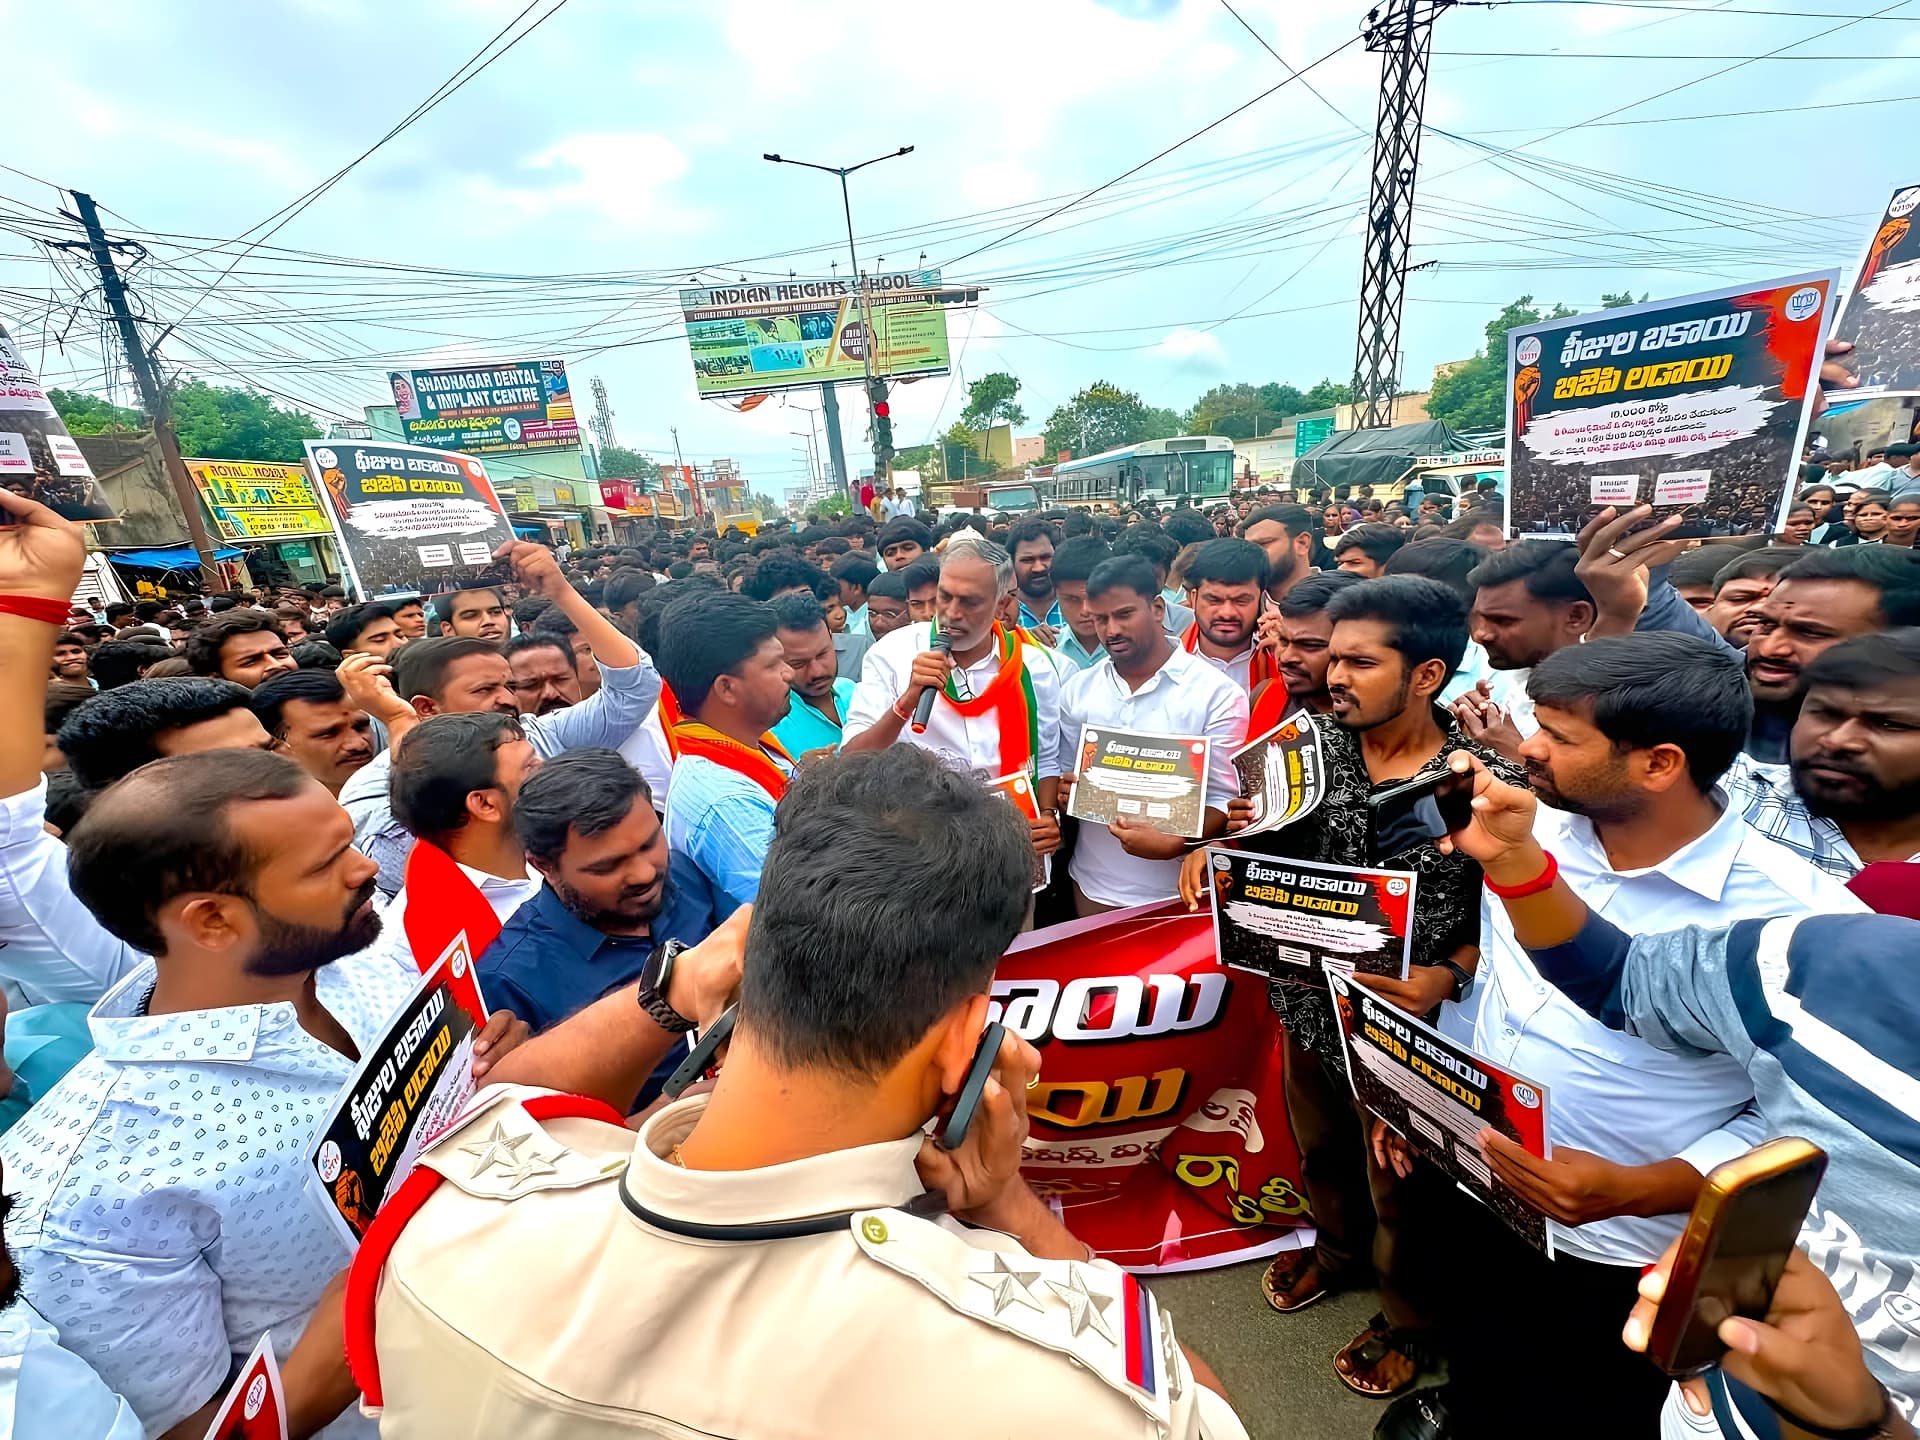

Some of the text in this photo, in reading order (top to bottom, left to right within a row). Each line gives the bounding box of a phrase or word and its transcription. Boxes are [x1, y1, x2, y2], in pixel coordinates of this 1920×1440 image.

[710, 274, 914, 305] INDIAN HEIGHTS HOOL
[1559, 311, 1752, 368] ఫీజుల బకాయి
[415, 368, 540, 392] SHADNAGAR DENTAL
[1553, 354, 1734, 400] బిజెపి లడాయి
[427, 386, 540, 410] & IMPLANT CENTRE
[355, 450, 460, 475] ఫీజుల బకాయి
[361, 475, 464, 494] బిజెపి లడాయి
[1245, 861, 1367, 896] ఫీజుల బకాయి
[1244, 884, 1360, 916] బిజెపి లడాయి
[1361, 997, 1488, 1090] ఫీజుల బకాయి
[350, 988, 445, 1142] ఫీజుల బకాయి
[1364, 1022, 1408, 1063] బిజెపి
[1410, 1055, 1481, 1111] లడాయి
[369, 1095, 408, 1177] బిజెపి
[403, 1024, 452, 1112] లడాయి
